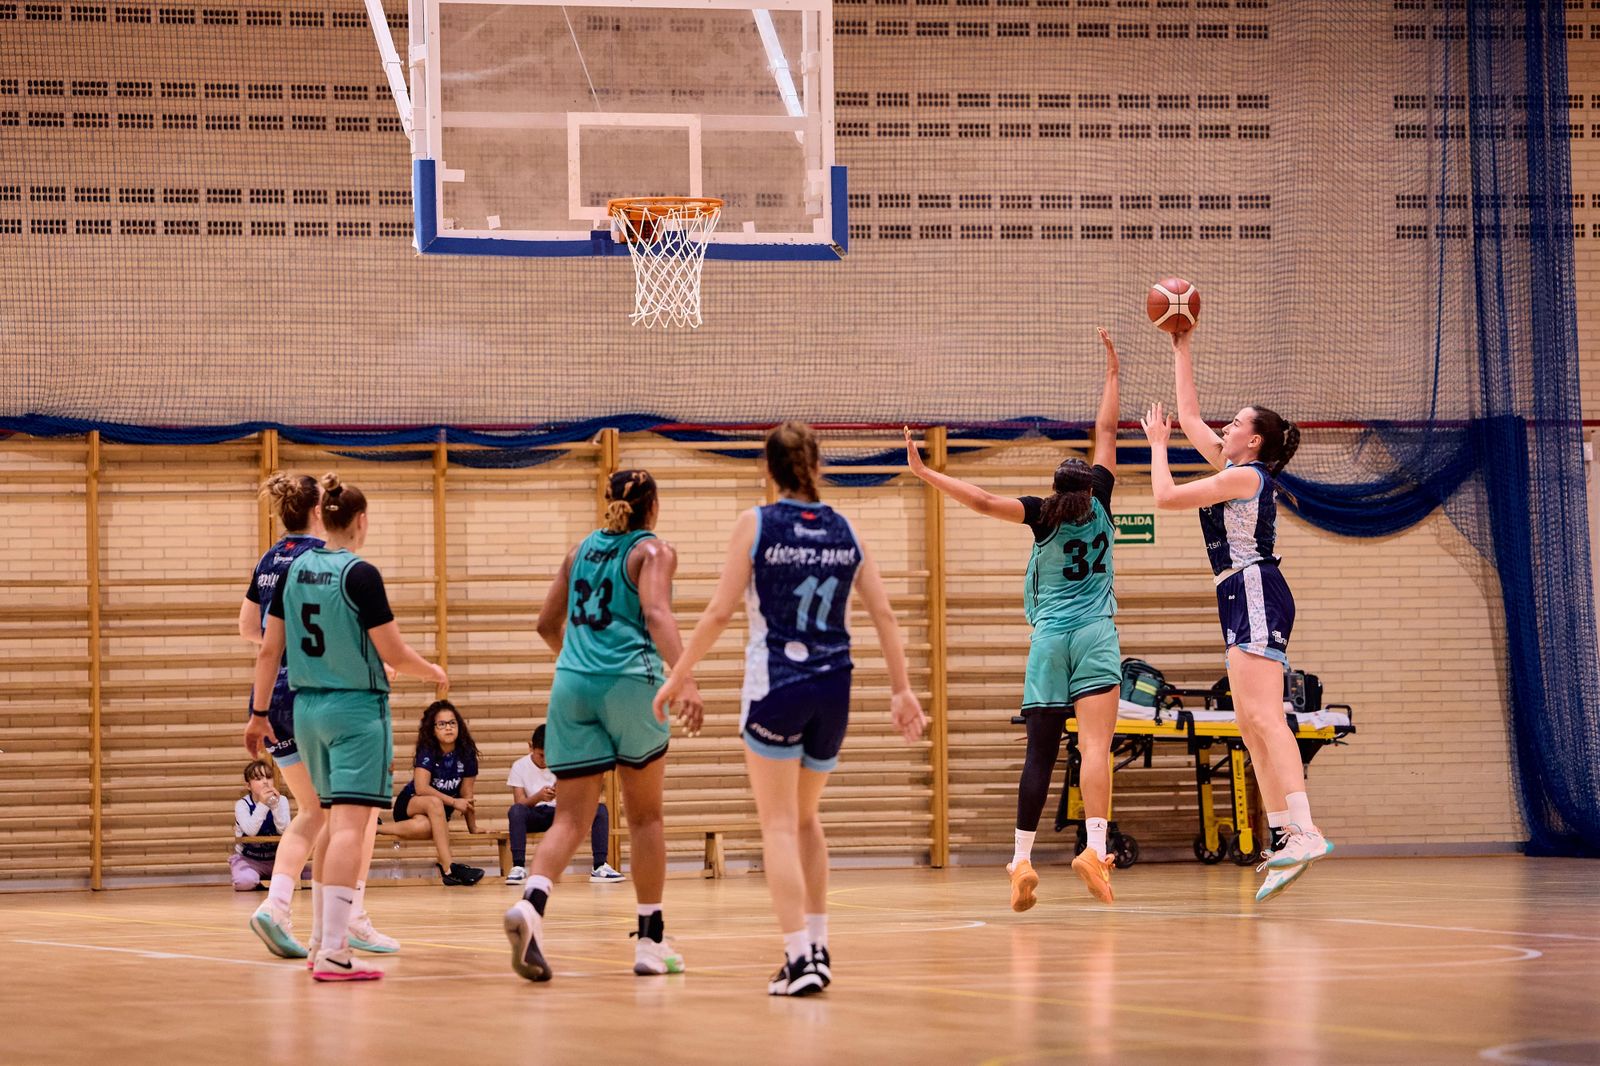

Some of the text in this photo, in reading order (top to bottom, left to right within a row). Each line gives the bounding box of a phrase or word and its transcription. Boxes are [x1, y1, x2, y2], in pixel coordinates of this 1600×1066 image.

[1114, 516, 1153, 526] SALIDA
[1062, 531, 1110, 581] 32
[571, 578, 613, 631] 33
[793, 575, 839, 631] 11
[301, 603, 325, 657] 5
